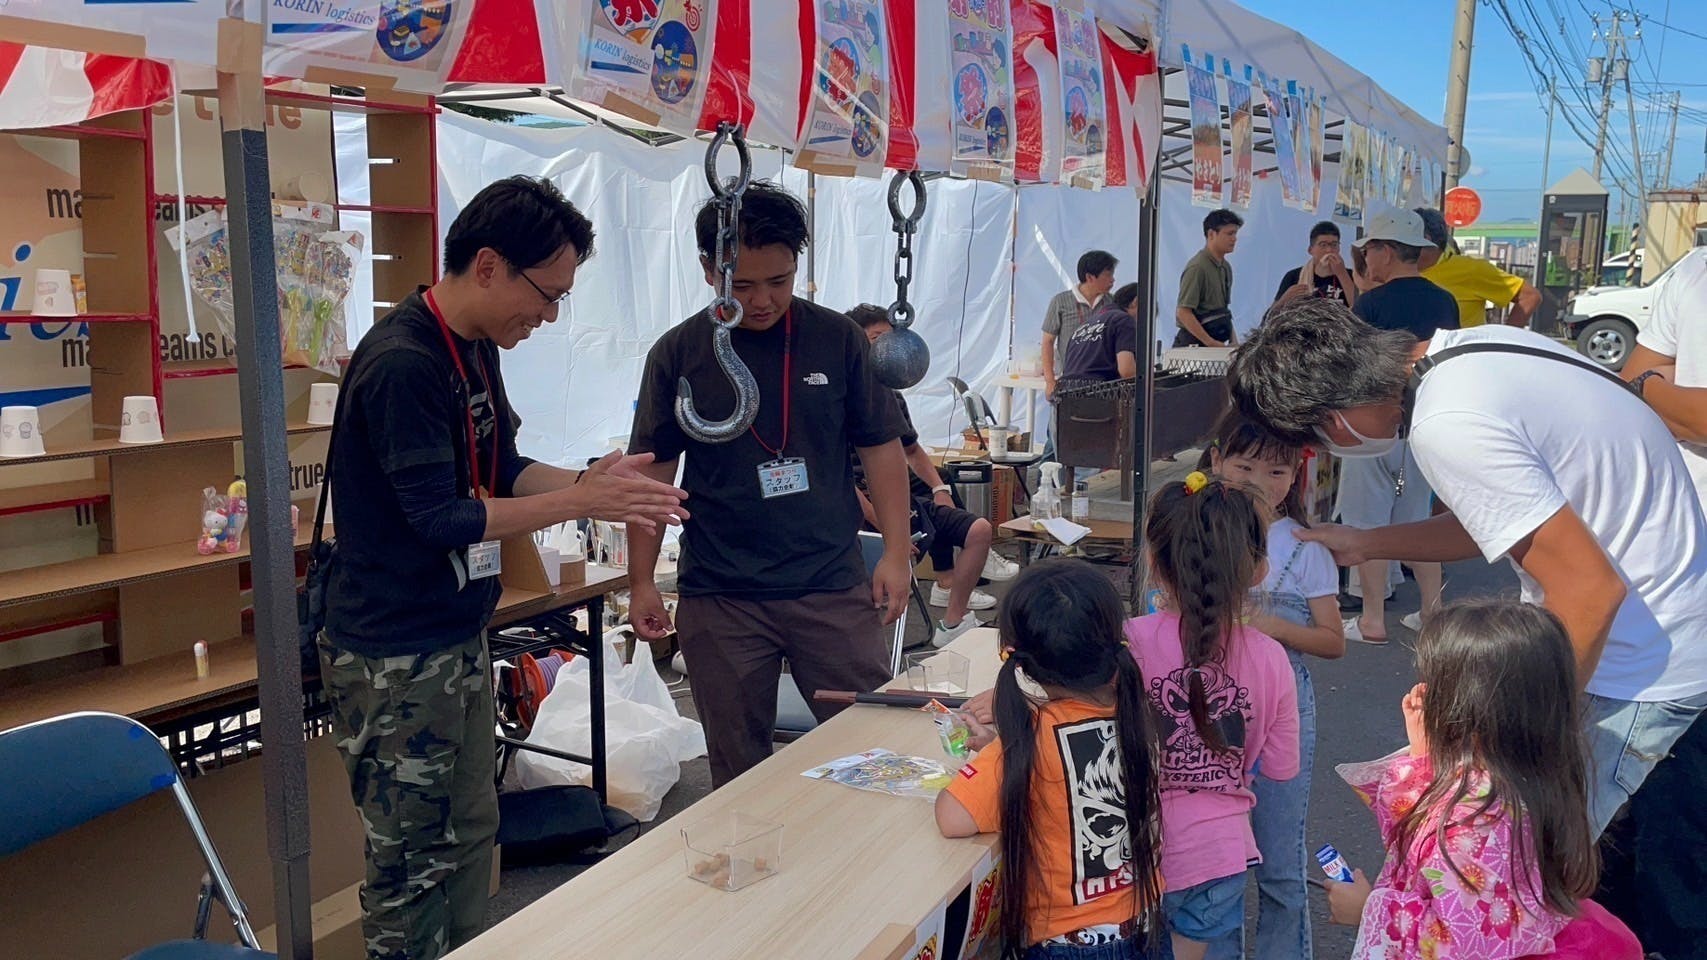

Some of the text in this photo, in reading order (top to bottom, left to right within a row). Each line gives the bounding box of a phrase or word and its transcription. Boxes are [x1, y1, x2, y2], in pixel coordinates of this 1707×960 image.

[273, 0, 376, 26] KORIN logistics
[594, 38, 651, 72] KORIN logistics
[288, 460, 325, 491] true
[766, 474, 801, 487] スタッフ
[1160, 769, 1226, 783] YSTERIC
